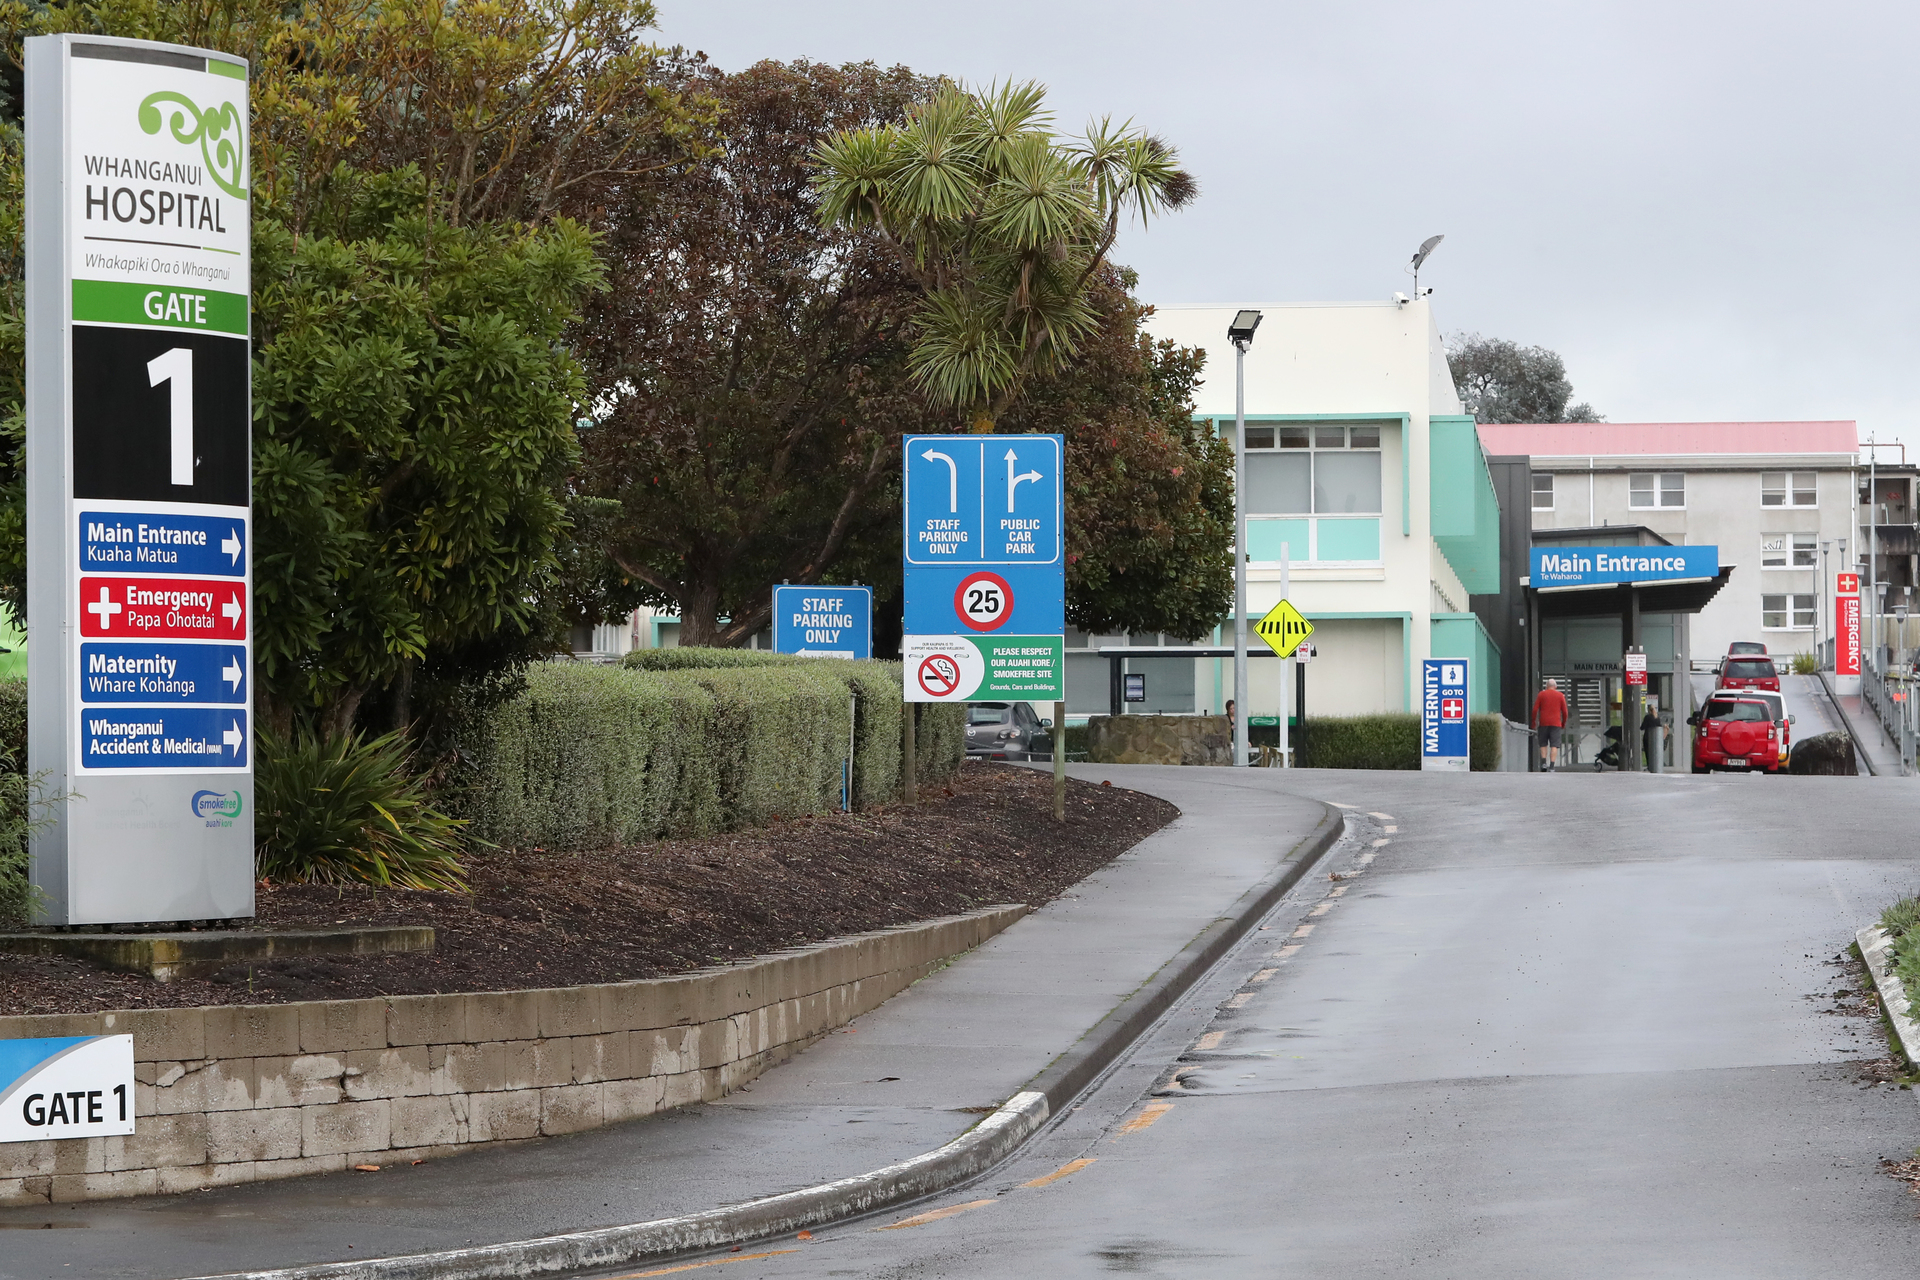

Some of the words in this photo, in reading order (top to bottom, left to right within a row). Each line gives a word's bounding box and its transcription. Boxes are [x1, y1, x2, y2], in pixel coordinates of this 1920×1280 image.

[84, 155, 202, 186] WHANGANUI
[86, 185, 226, 233] HOSPITAL
[85, 253, 149, 274] Whakapiki
[151, 258, 171, 274] Ora
[173, 260, 180, 275] ō
[182, 261, 231, 282] Whanganui
[143, 290, 207, 324] GATE
[146, 347, 194, 486] 1
[926, 519, 961, 530] STAFF
[1000, 519, 1041, 530] PUBLIC
[87, 522, 134, 543] Main
[138, 523, 207, 546] Entrance
[919, 531, 968, 542] PARKING
[1009, 531, 1032, 542] CAR
[87, 545, 132, 562] Kuaha
[136, 546, 178, 563] Matua
[929, 543, 958, 554] ONLY
[1005, 543, 1036, 554] PARK
[1540, 553, 1592, 573] Main
[1596, 553, 1686, 572] Entrance
[1550, 572, 1582, 580] Waharoa
[126, 585, 214, 612] Emergency
[802, 598, 844, 612] STAFF
[968, 589, 999, 614] 25
[128, 610, 161, 631] Papa
[166, 611, 215, 628] Ohotatai
[793, 613, 853, 628] PARKING
[805, 629, 841, 643] ONLY
[1848, 599, 1859, 672] EMERGENCY
[993, 647, 1020, 656] PLEASE
[1021, 647, 1052, 656] RESPECT
[89, 653, 177, 680] Maternity
[990, 658, 1006, 667] OUR
[1007, 658, 1031, 667] AUAHI
[1031, 658, 1050, 667] KORE
[1051, 658, 1056, 668] /
[993, 670, 1035, 678] SMOKEFREE
[1036, 670, 1052, 678] SITE
[88, 675, 136, 693] Whare
[140, 676, 195, 697] Kohanga
[990, 683, 1011, 691] Grounds,
[1033, 683, 1056, 692] Buildings.
[1425, 663, 1439, 753] MATERNITY
[89, 718, 163, 740] Whanganui
[89, 738, 149, 755] Accident
[152, 738, 162, 754] &
[164, 738, 206, 754] Medical
[199, 797, 237, 810] smokefree
[221, 819, 233, 828] kore
[22, 1090, 104, 1127] GATE
[113, 1083, 126, 1122] 1
